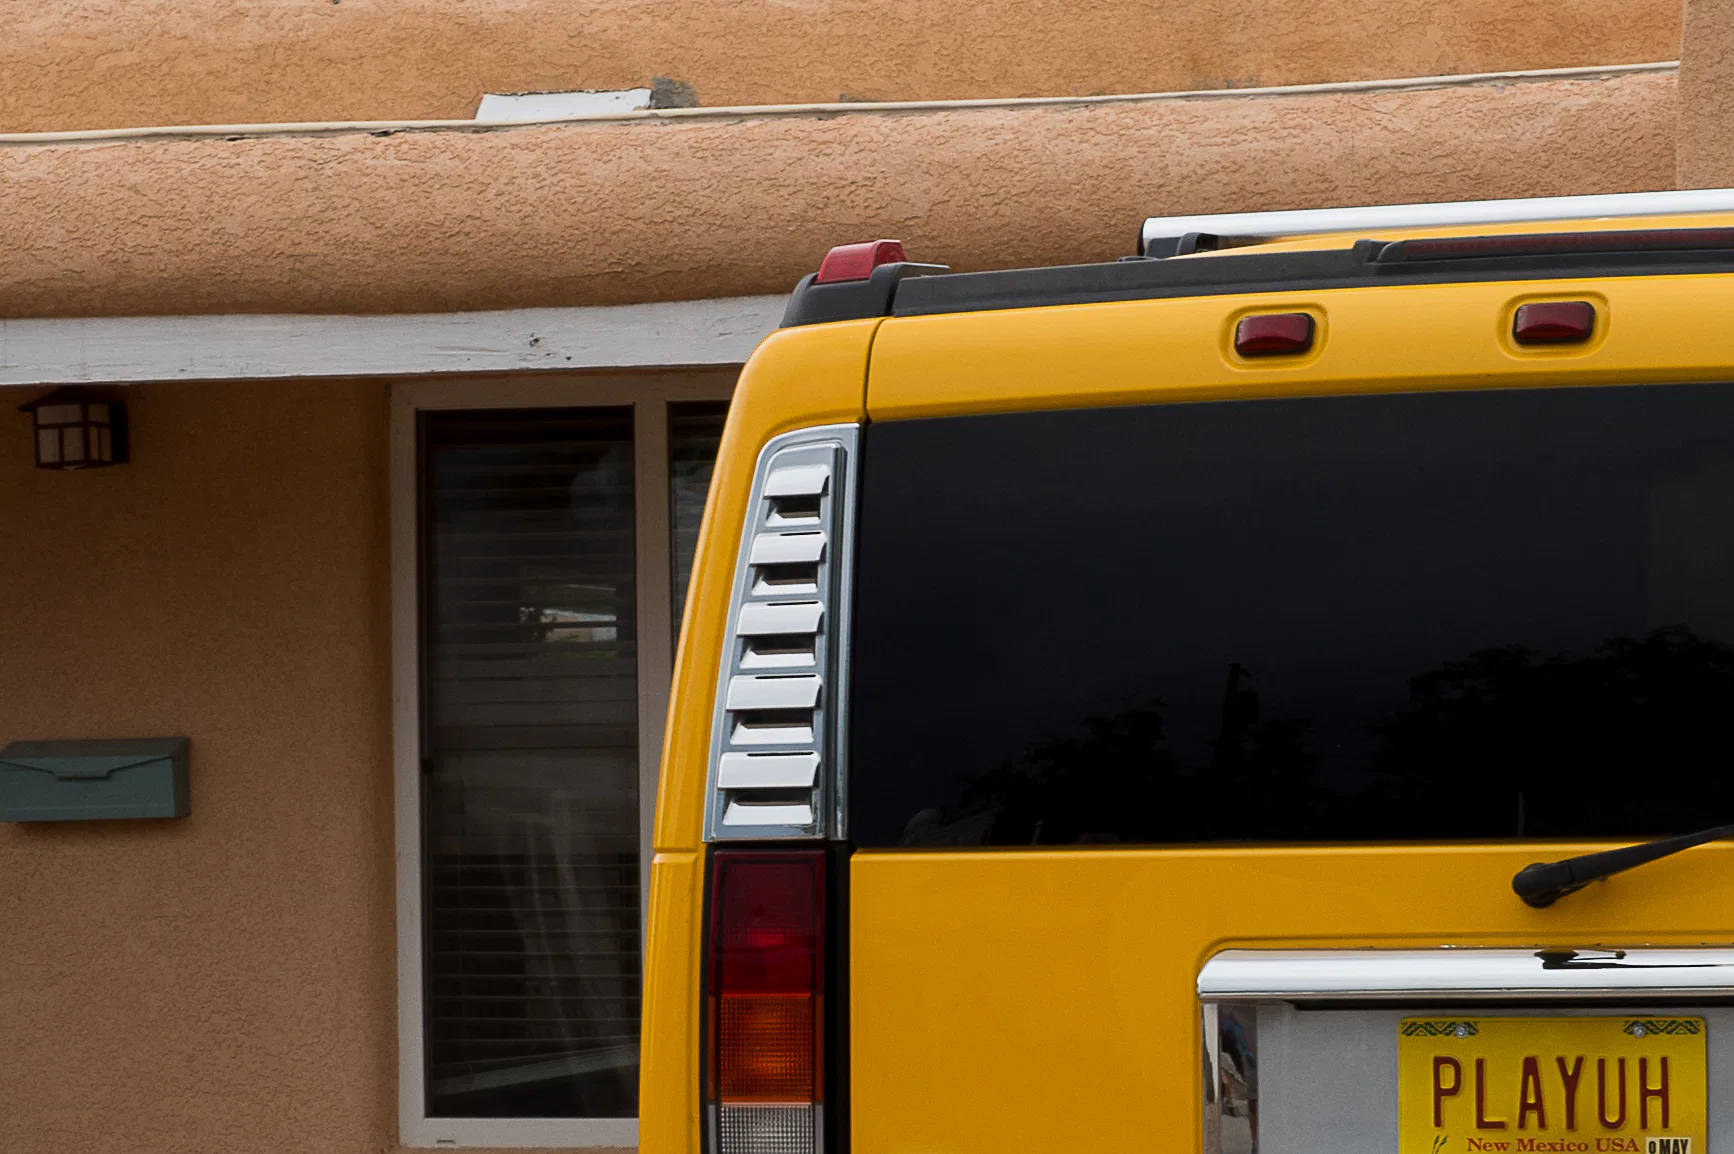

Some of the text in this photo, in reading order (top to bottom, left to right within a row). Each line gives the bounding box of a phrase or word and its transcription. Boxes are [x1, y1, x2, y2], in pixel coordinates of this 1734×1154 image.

[1433, 1056, 1669, 1129] PLAYUH
[1467, 1138, 1640, 1153] New Mexico USA
